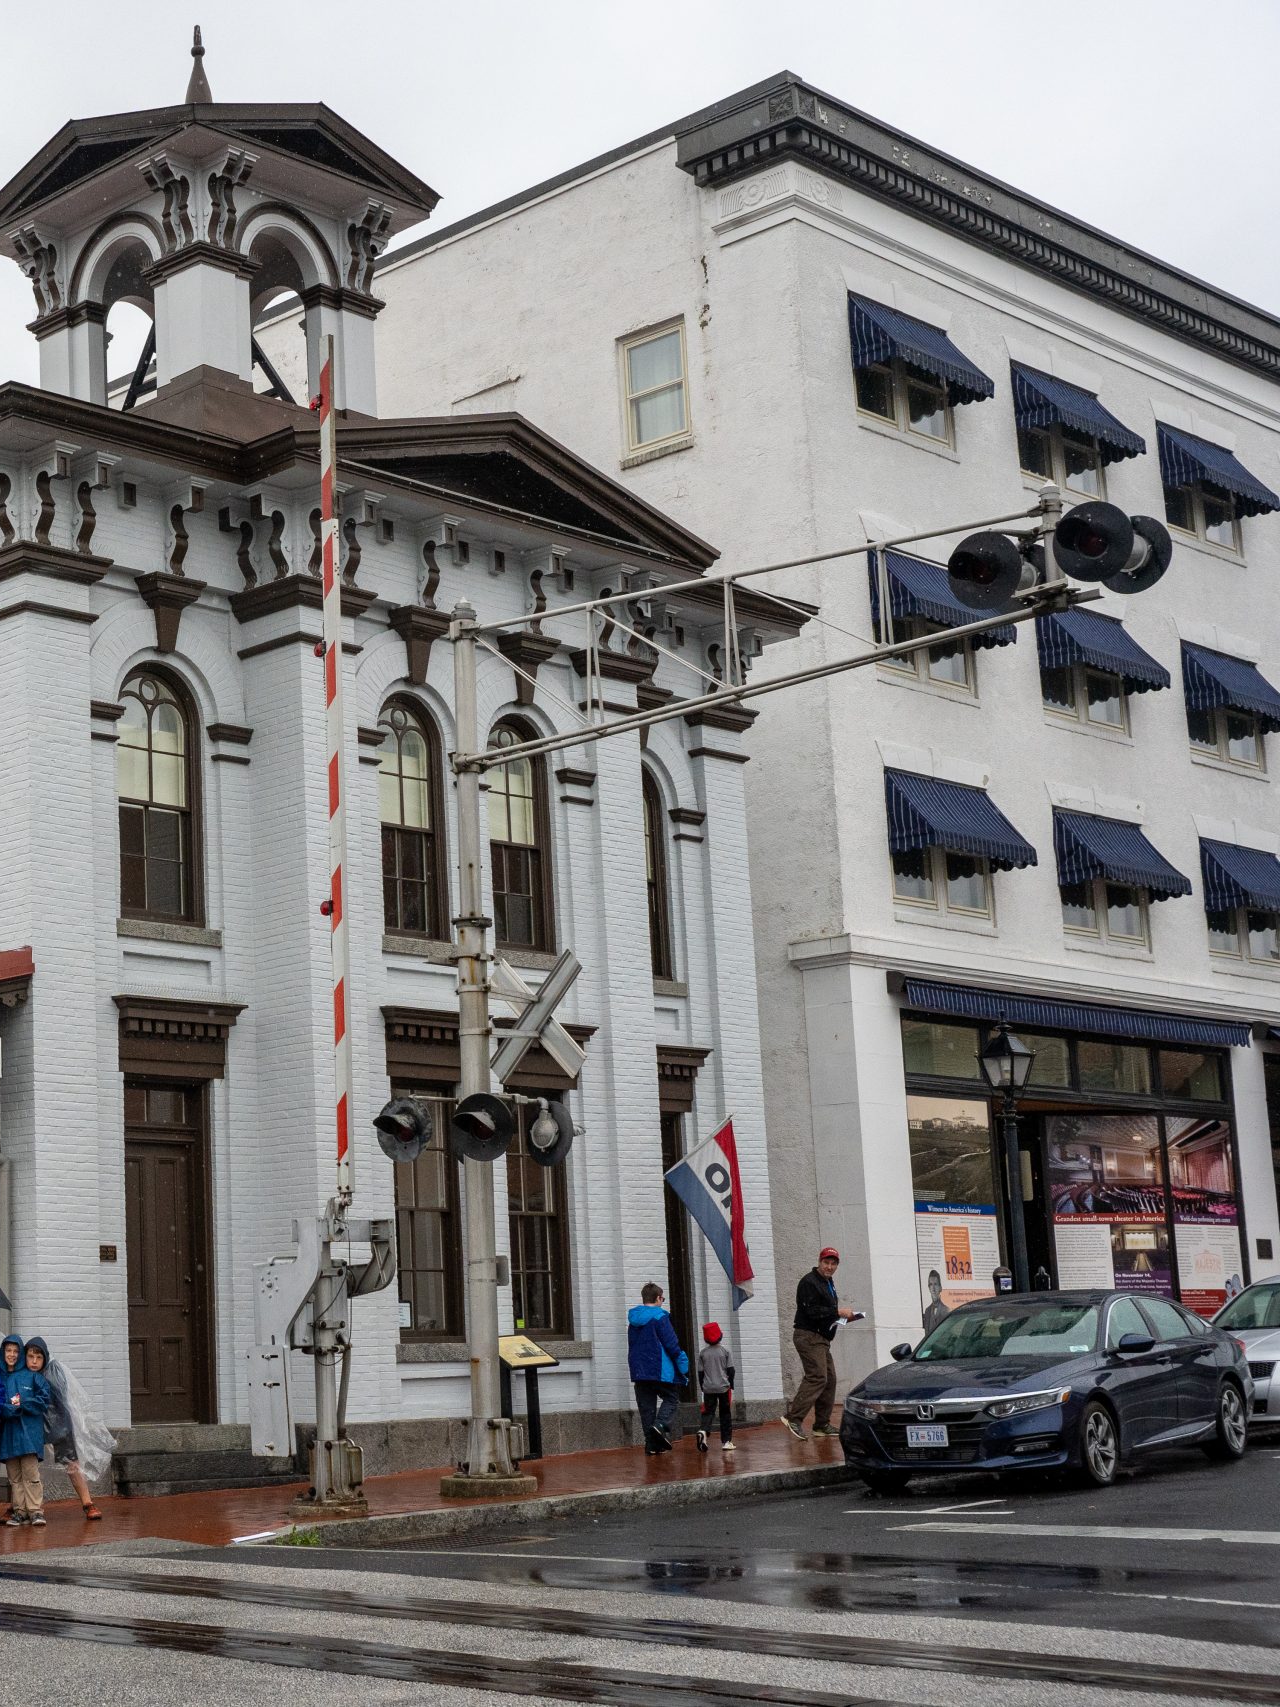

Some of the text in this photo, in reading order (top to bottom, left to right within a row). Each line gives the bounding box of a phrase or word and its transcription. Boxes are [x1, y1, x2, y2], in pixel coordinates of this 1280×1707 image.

[968, 1206, 981, 1215] history
[946, 1255, 972, 1278] 1832
[910, 1431, 944, 1441] FX 5766
